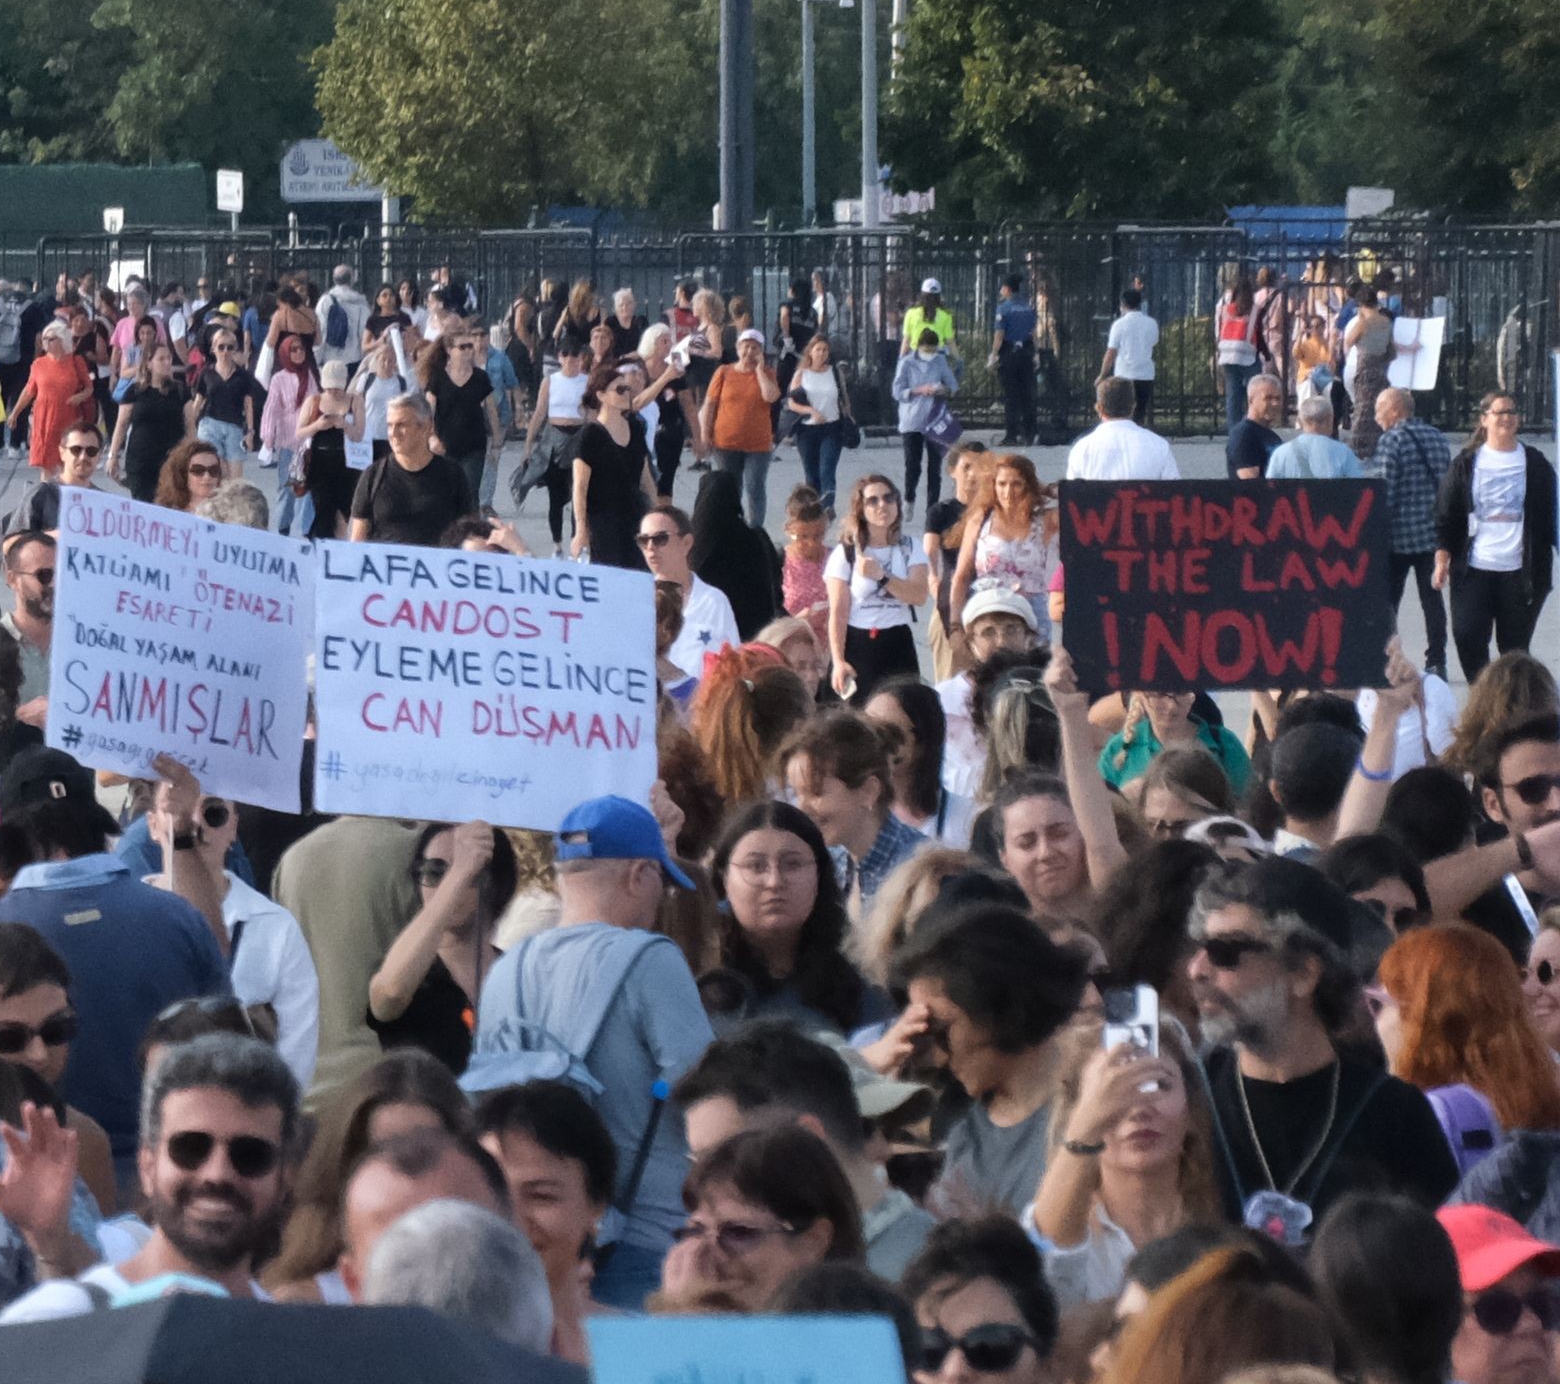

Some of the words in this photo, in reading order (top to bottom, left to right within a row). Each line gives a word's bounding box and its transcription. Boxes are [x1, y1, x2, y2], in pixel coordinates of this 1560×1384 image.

[1069, 488, 1375, 551] WITHDRAW
[323, 549, 439, 590] LAFA
[447, 558, 601, 603] GELİNCE
[1102, 548, 1213, 593] THE
[1241, 550, 1370, 592] LAW
[116, 591, 213, 632] ESARETİ
[134, 638, 197, 669] YAŞAM
[323, 634, 483, 688] EYLEME
[493, 650, 649, 704] GELİNCE
[1139, 607, 1344, 685] NOW!
[63, 660, 280, 761] SANMIŞLAR
[361, 692, 443, 738] CAN
[471, 693, 642, 751] DÜŞMAN
